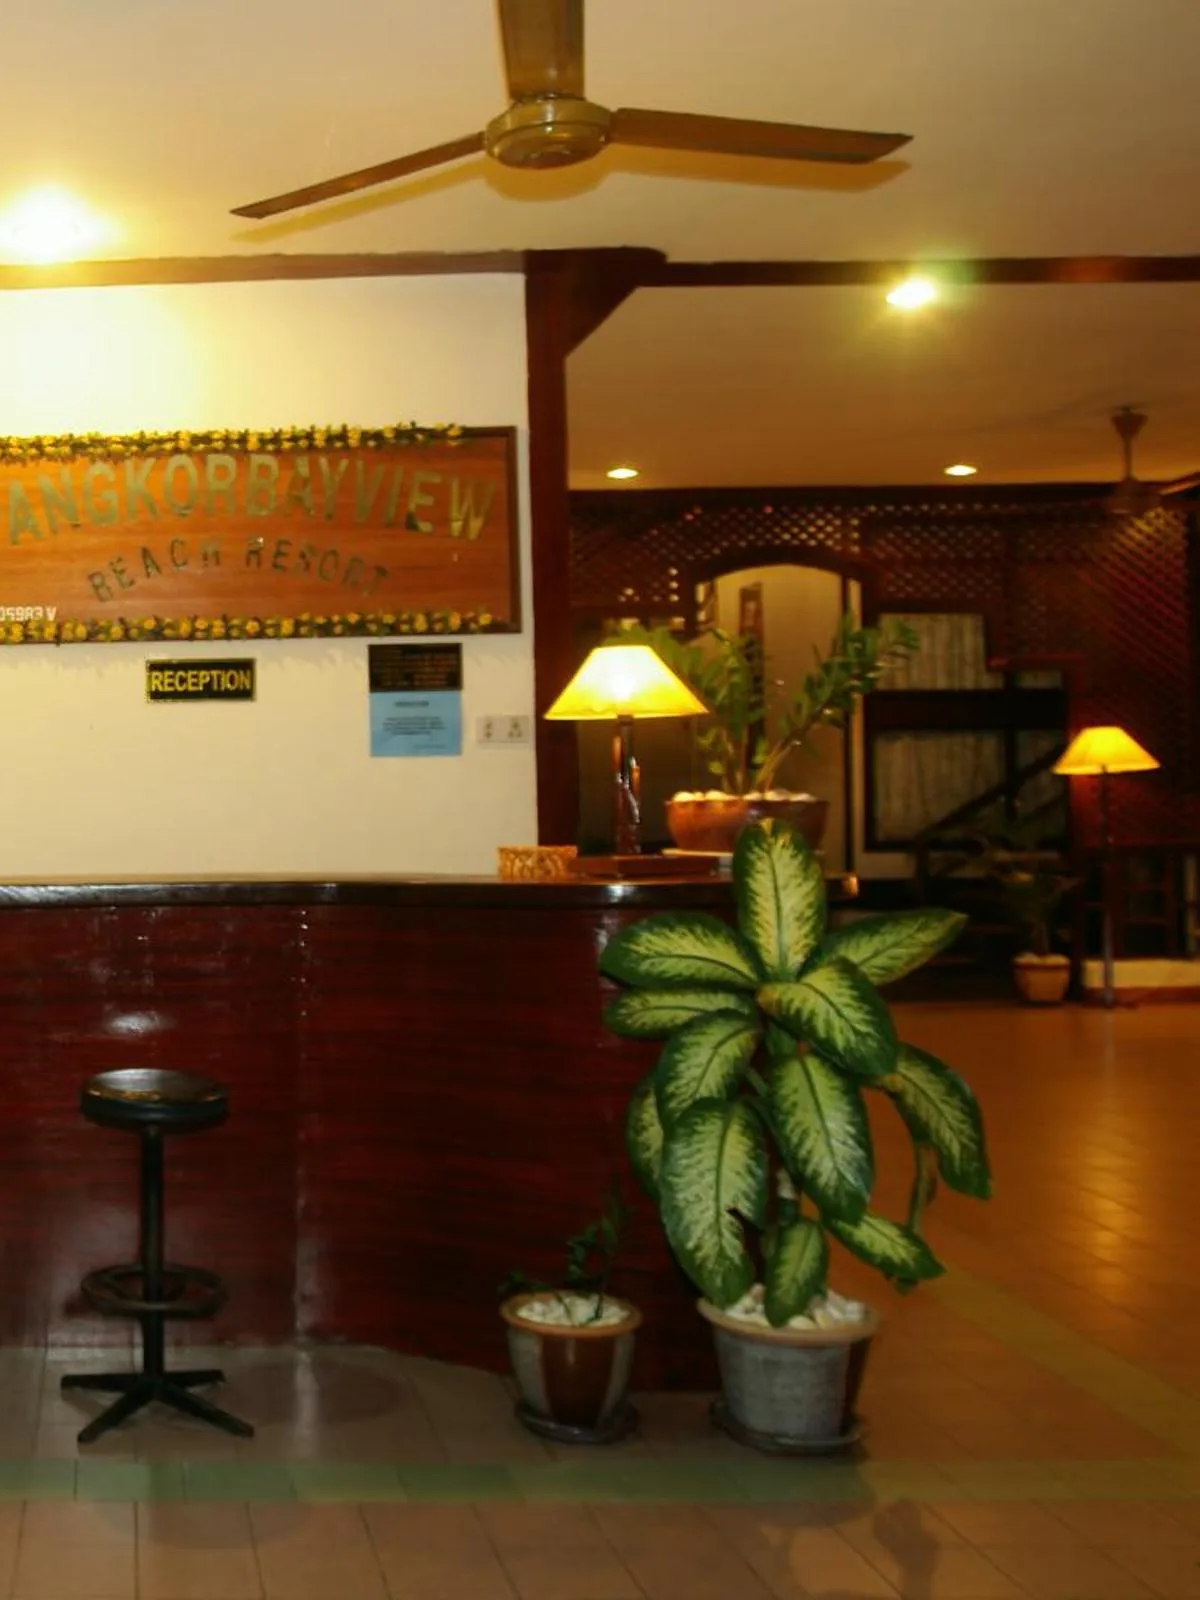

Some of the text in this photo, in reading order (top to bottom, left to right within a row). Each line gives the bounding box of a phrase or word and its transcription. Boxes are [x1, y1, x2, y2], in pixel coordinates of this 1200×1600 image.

[87, 536, 390, 603] BEACH RESORT
[151, 669, 252, 692] RECEPTION
